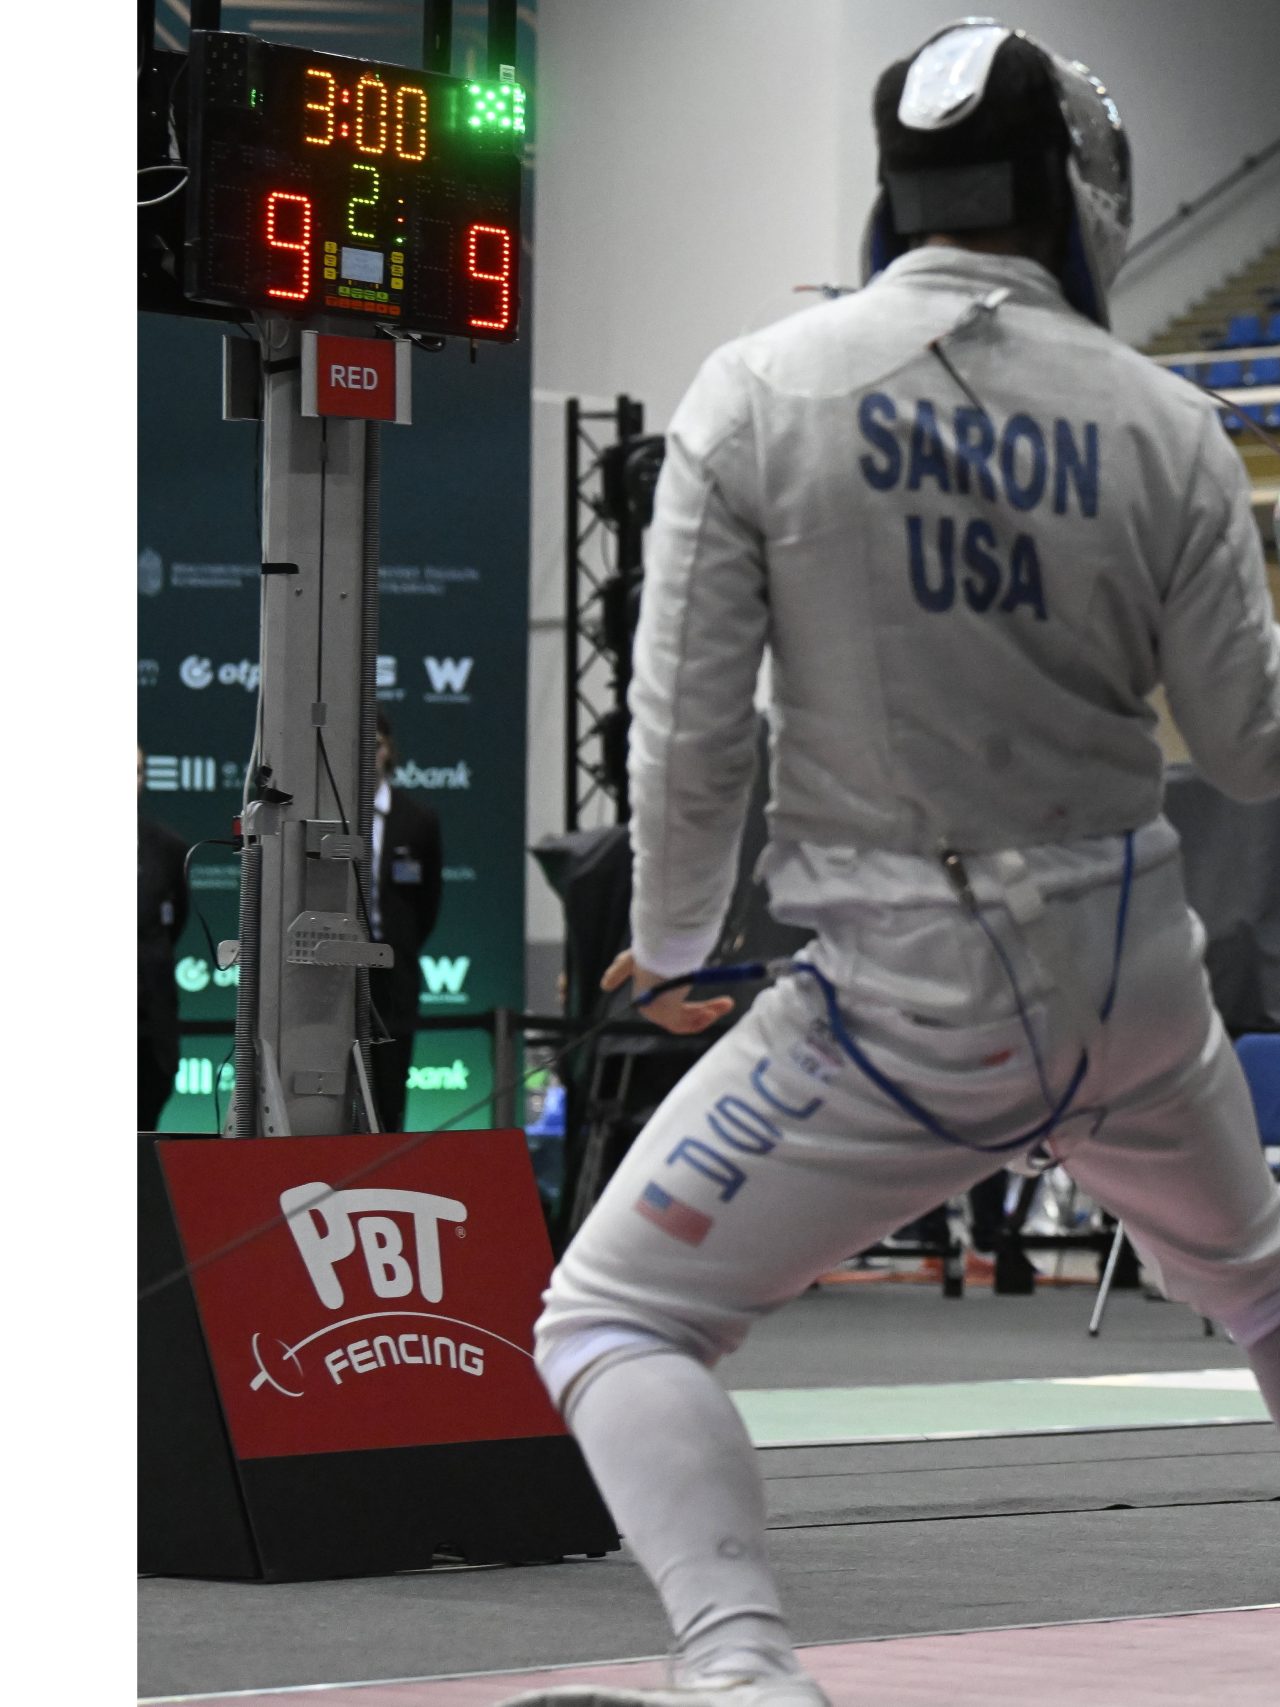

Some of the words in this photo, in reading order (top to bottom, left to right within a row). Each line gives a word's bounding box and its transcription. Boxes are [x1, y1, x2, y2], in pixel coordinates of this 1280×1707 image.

[306, 68, 427, 161] 3:00
[267, 191, 311, 299] 9
[469, 223, 511, 329] 9
[330, 364, 378, 391] RED
[857, 391, 1099, 518] SARON
[906, 514, 1048, 622] USA
[279, 1181, 468, 1310] PBT
[324, 1333, 484, 1385] FENCING
